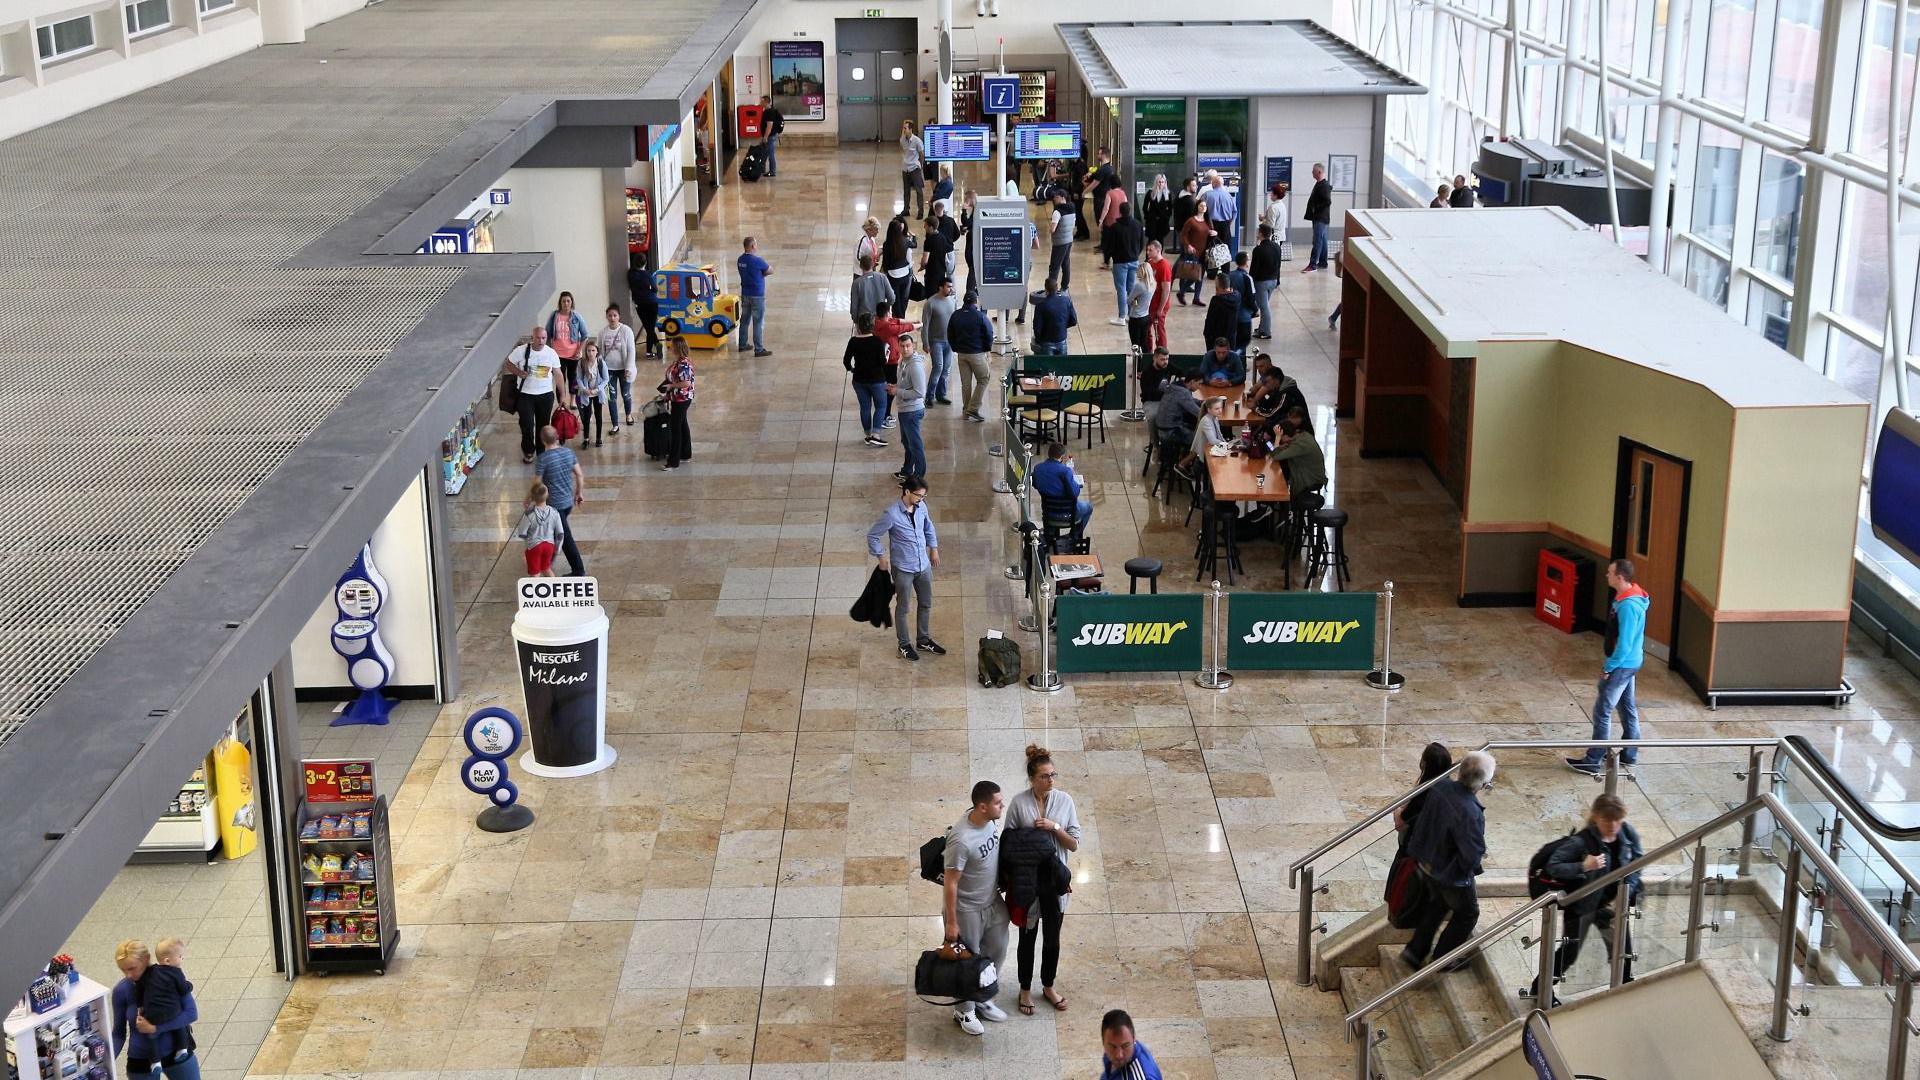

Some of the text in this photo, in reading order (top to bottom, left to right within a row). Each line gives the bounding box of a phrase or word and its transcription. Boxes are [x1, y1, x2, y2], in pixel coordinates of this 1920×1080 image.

[1145, 102, 1175, 111] Europcar
[1143, 127, 1177, 136] Europcar
[521, 583, 595, 599] COFFEE
[522, 600, 570, 608] AVAILABLE
[1072, 621, 1188, 647] SUBWAY
[1242, 620, 1360, 644] SUBWAY
[532, 650, 581, 665] NESCAFÉ
[529, 665, 588, 686] Milano
[305, 769, 316, 785] 3
[326, 770, 336, 785] 2
[473, 768, 495, 777] PLAY
[977, 830, 1000, 859] BOS
